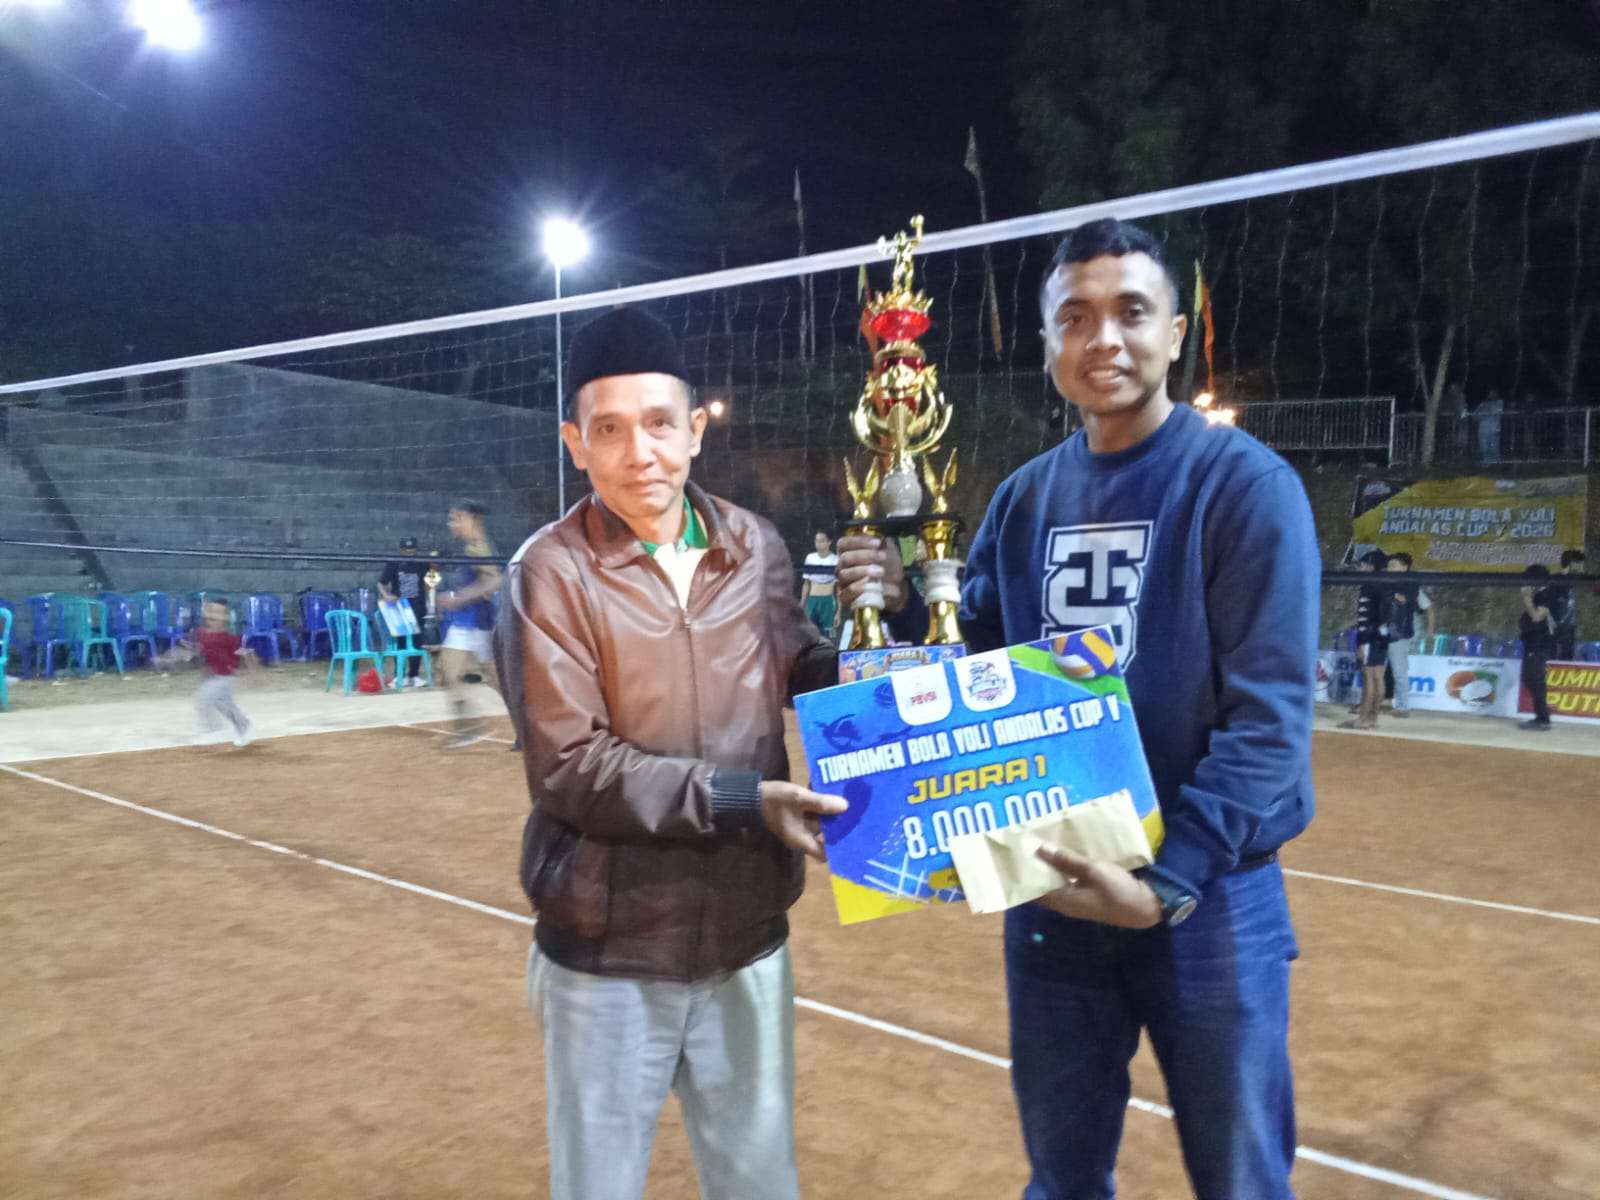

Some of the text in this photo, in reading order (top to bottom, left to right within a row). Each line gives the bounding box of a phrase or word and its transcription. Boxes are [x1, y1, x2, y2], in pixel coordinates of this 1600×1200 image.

[1456, 521, 1489, 537] CUP
[1469, 507, 1511, 522] BOLA
[817, 694, 1120, 784] TURNAMEN BOLA VOLI ANDALAS CUP V
[907, 755, 1048, 804] JUARA 1
